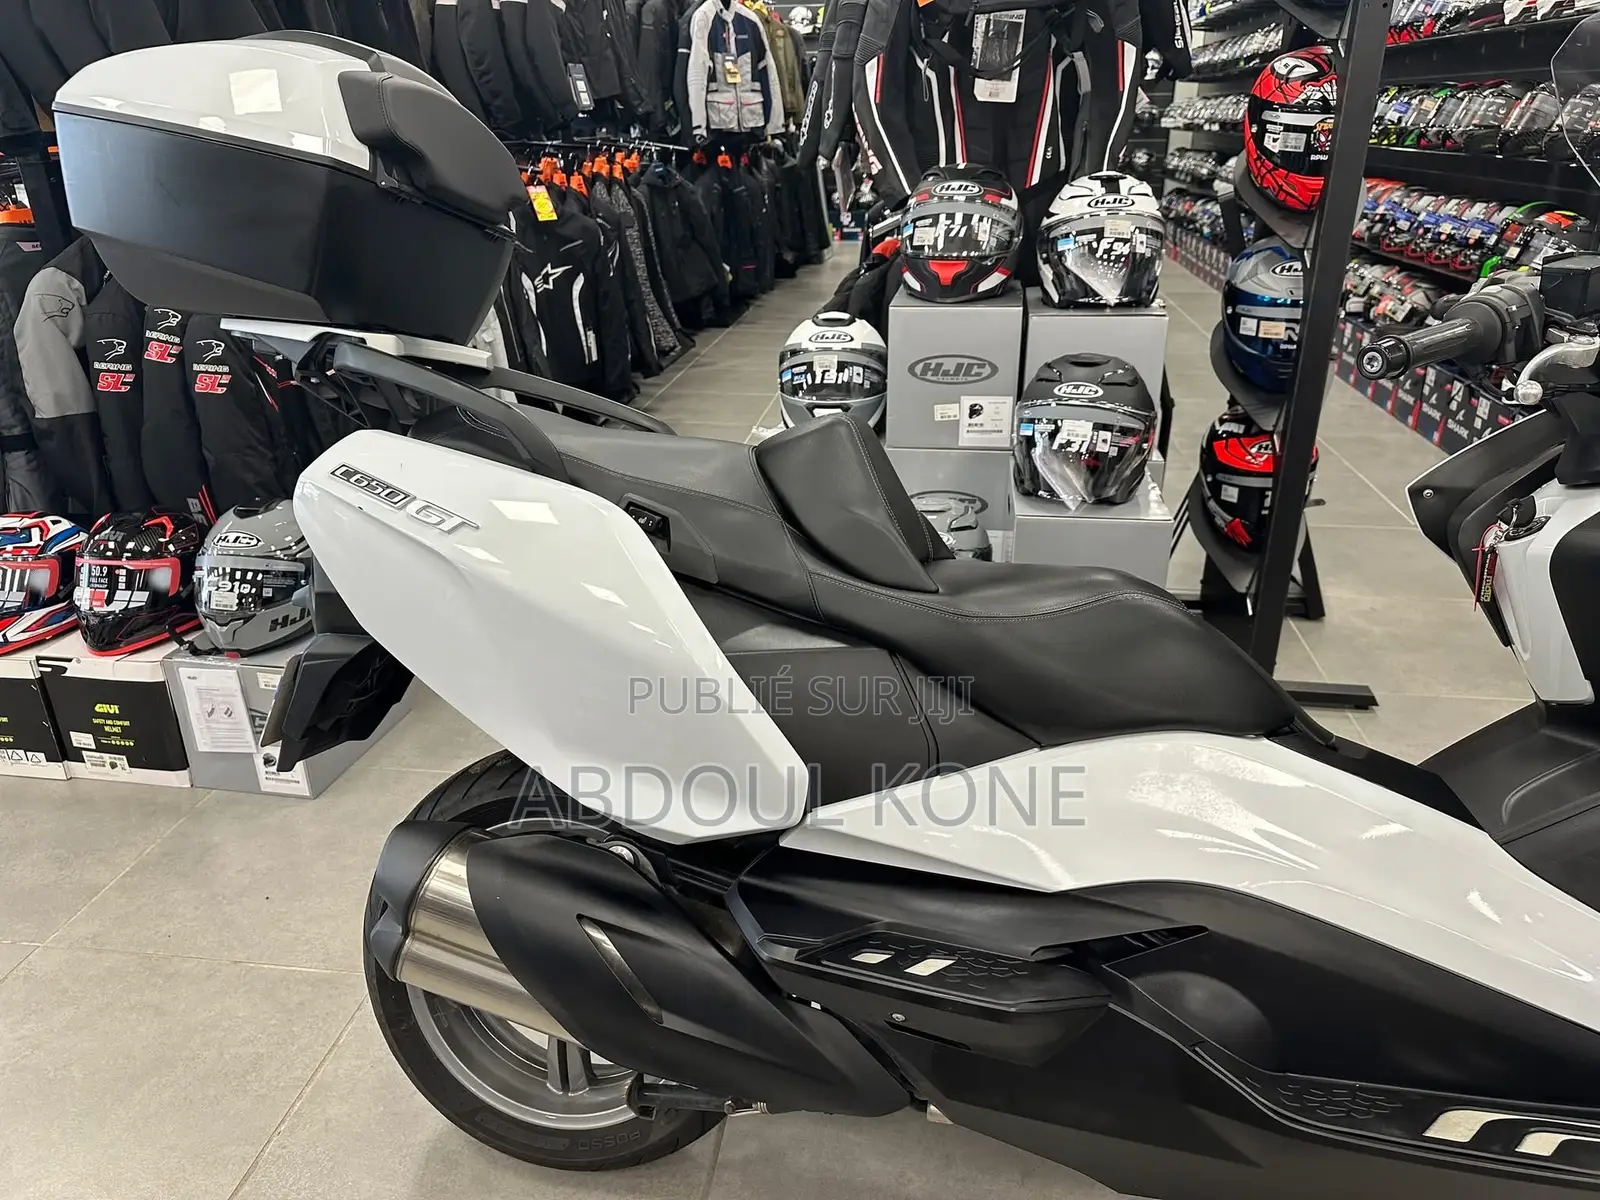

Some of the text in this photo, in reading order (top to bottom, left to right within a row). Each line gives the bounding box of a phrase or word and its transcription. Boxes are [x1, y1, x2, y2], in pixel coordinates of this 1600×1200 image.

[939, 183, 977, 193] HJC
[1094, 198, 1130, 207] HJC
[814, 333, 848, 341] HJC
[919, 362, 988, 378] HJC
[97, 372, 131, 393] SL
[194, 373, 228, 395] SL
[1059, 385, 1097, 395] HJC
[1447, 418, 1469, 440] SHARK
[405, 499, 480, 535] GT
[216, 535, 255, 545] HJC
[91, 565, 108, 577] 50.9
[94, 703, 120, 714] GIVI
